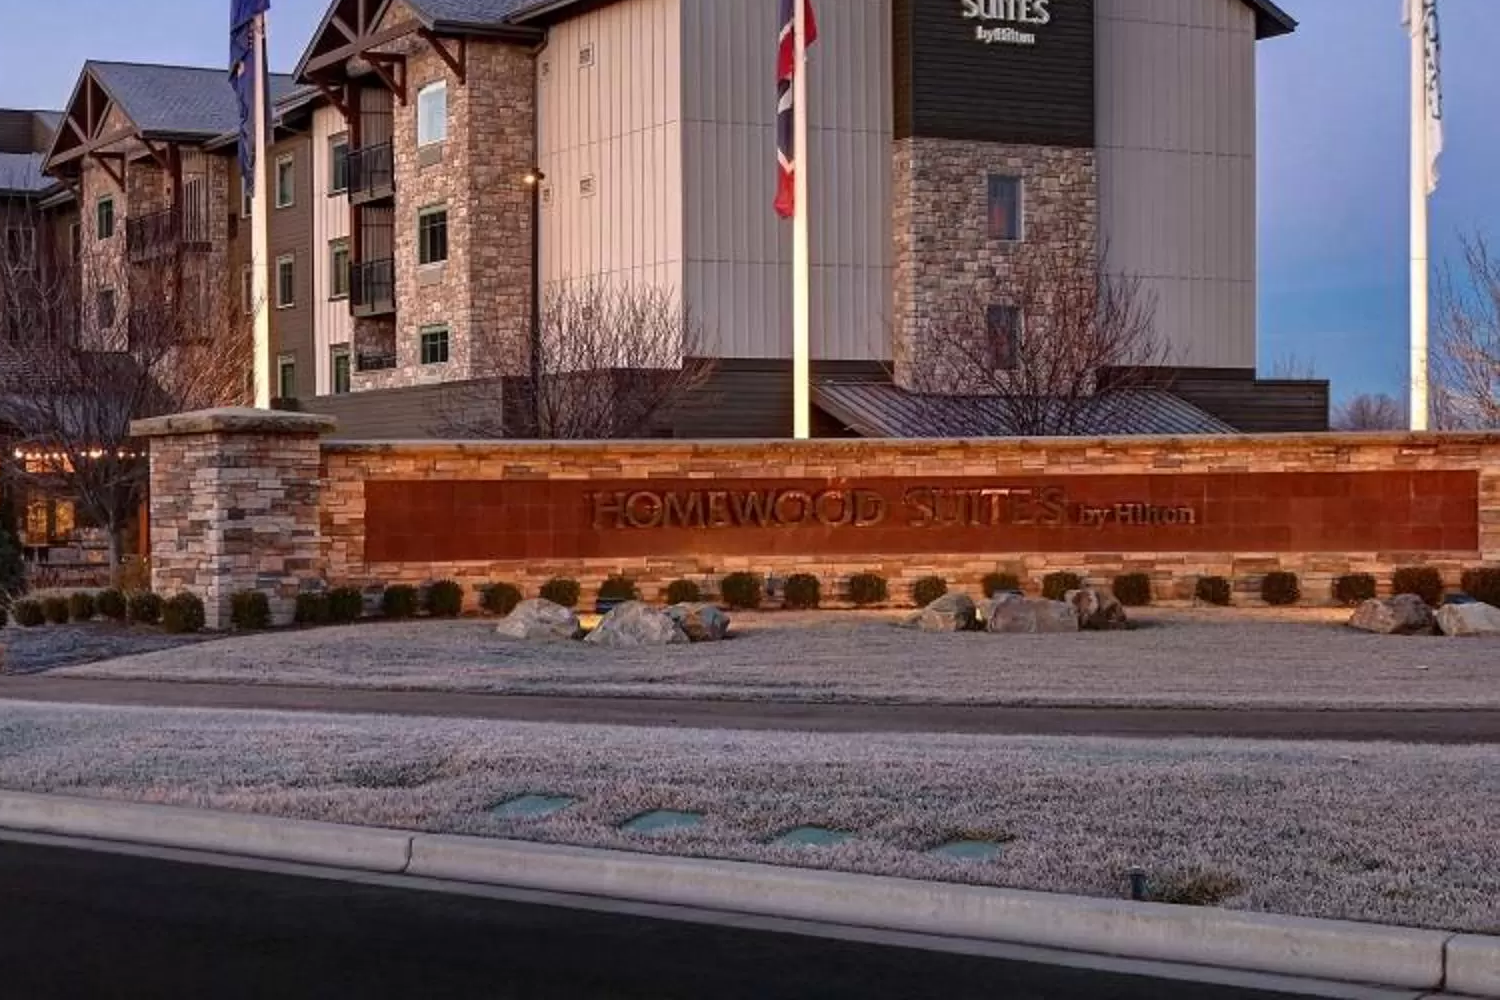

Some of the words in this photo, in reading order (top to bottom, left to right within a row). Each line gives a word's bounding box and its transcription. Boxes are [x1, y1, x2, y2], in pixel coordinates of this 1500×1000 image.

[591, 489, 886, 530] HOMEWOOD
[902, 486, 1066, 528] SUITES
[1077, 504, 1111, 529] by
[1111, 501, 1197, 526] Hilton
